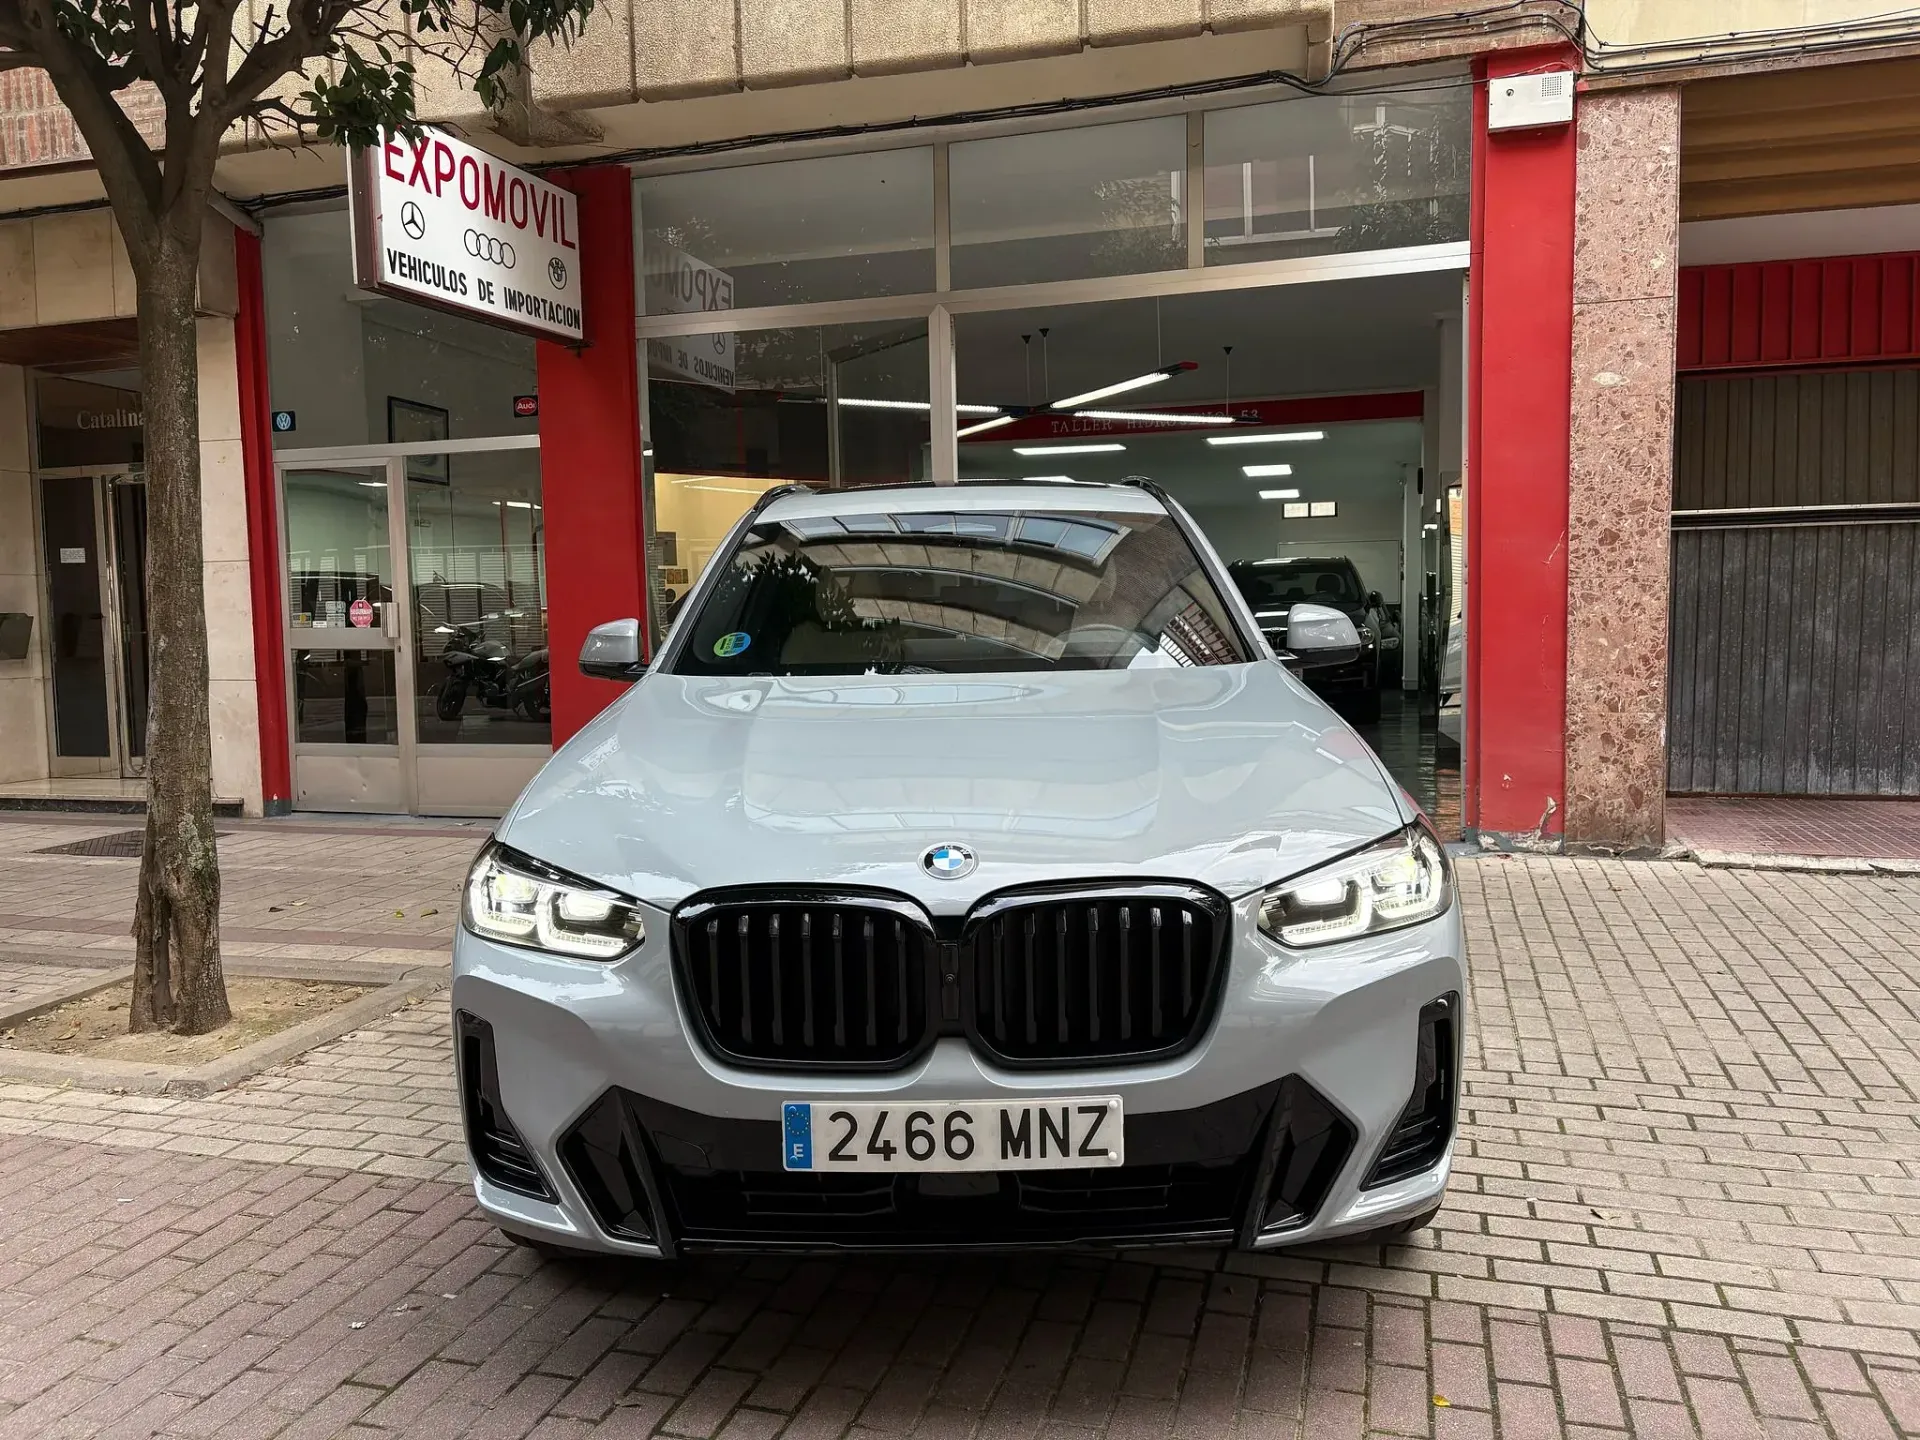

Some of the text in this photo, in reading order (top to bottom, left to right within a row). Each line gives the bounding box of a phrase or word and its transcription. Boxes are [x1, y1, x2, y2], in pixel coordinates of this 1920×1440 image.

[384, 124, 576, 250] EXPOMOVIL
[387, 247, 581, 331] VEHICULOS DE IMPORTACION
[1051, 419, 1113, 434] TALLER
[793, 1143, 804, 1158] E
[828, 1105, 1109, 1162] 2466 MNZ
